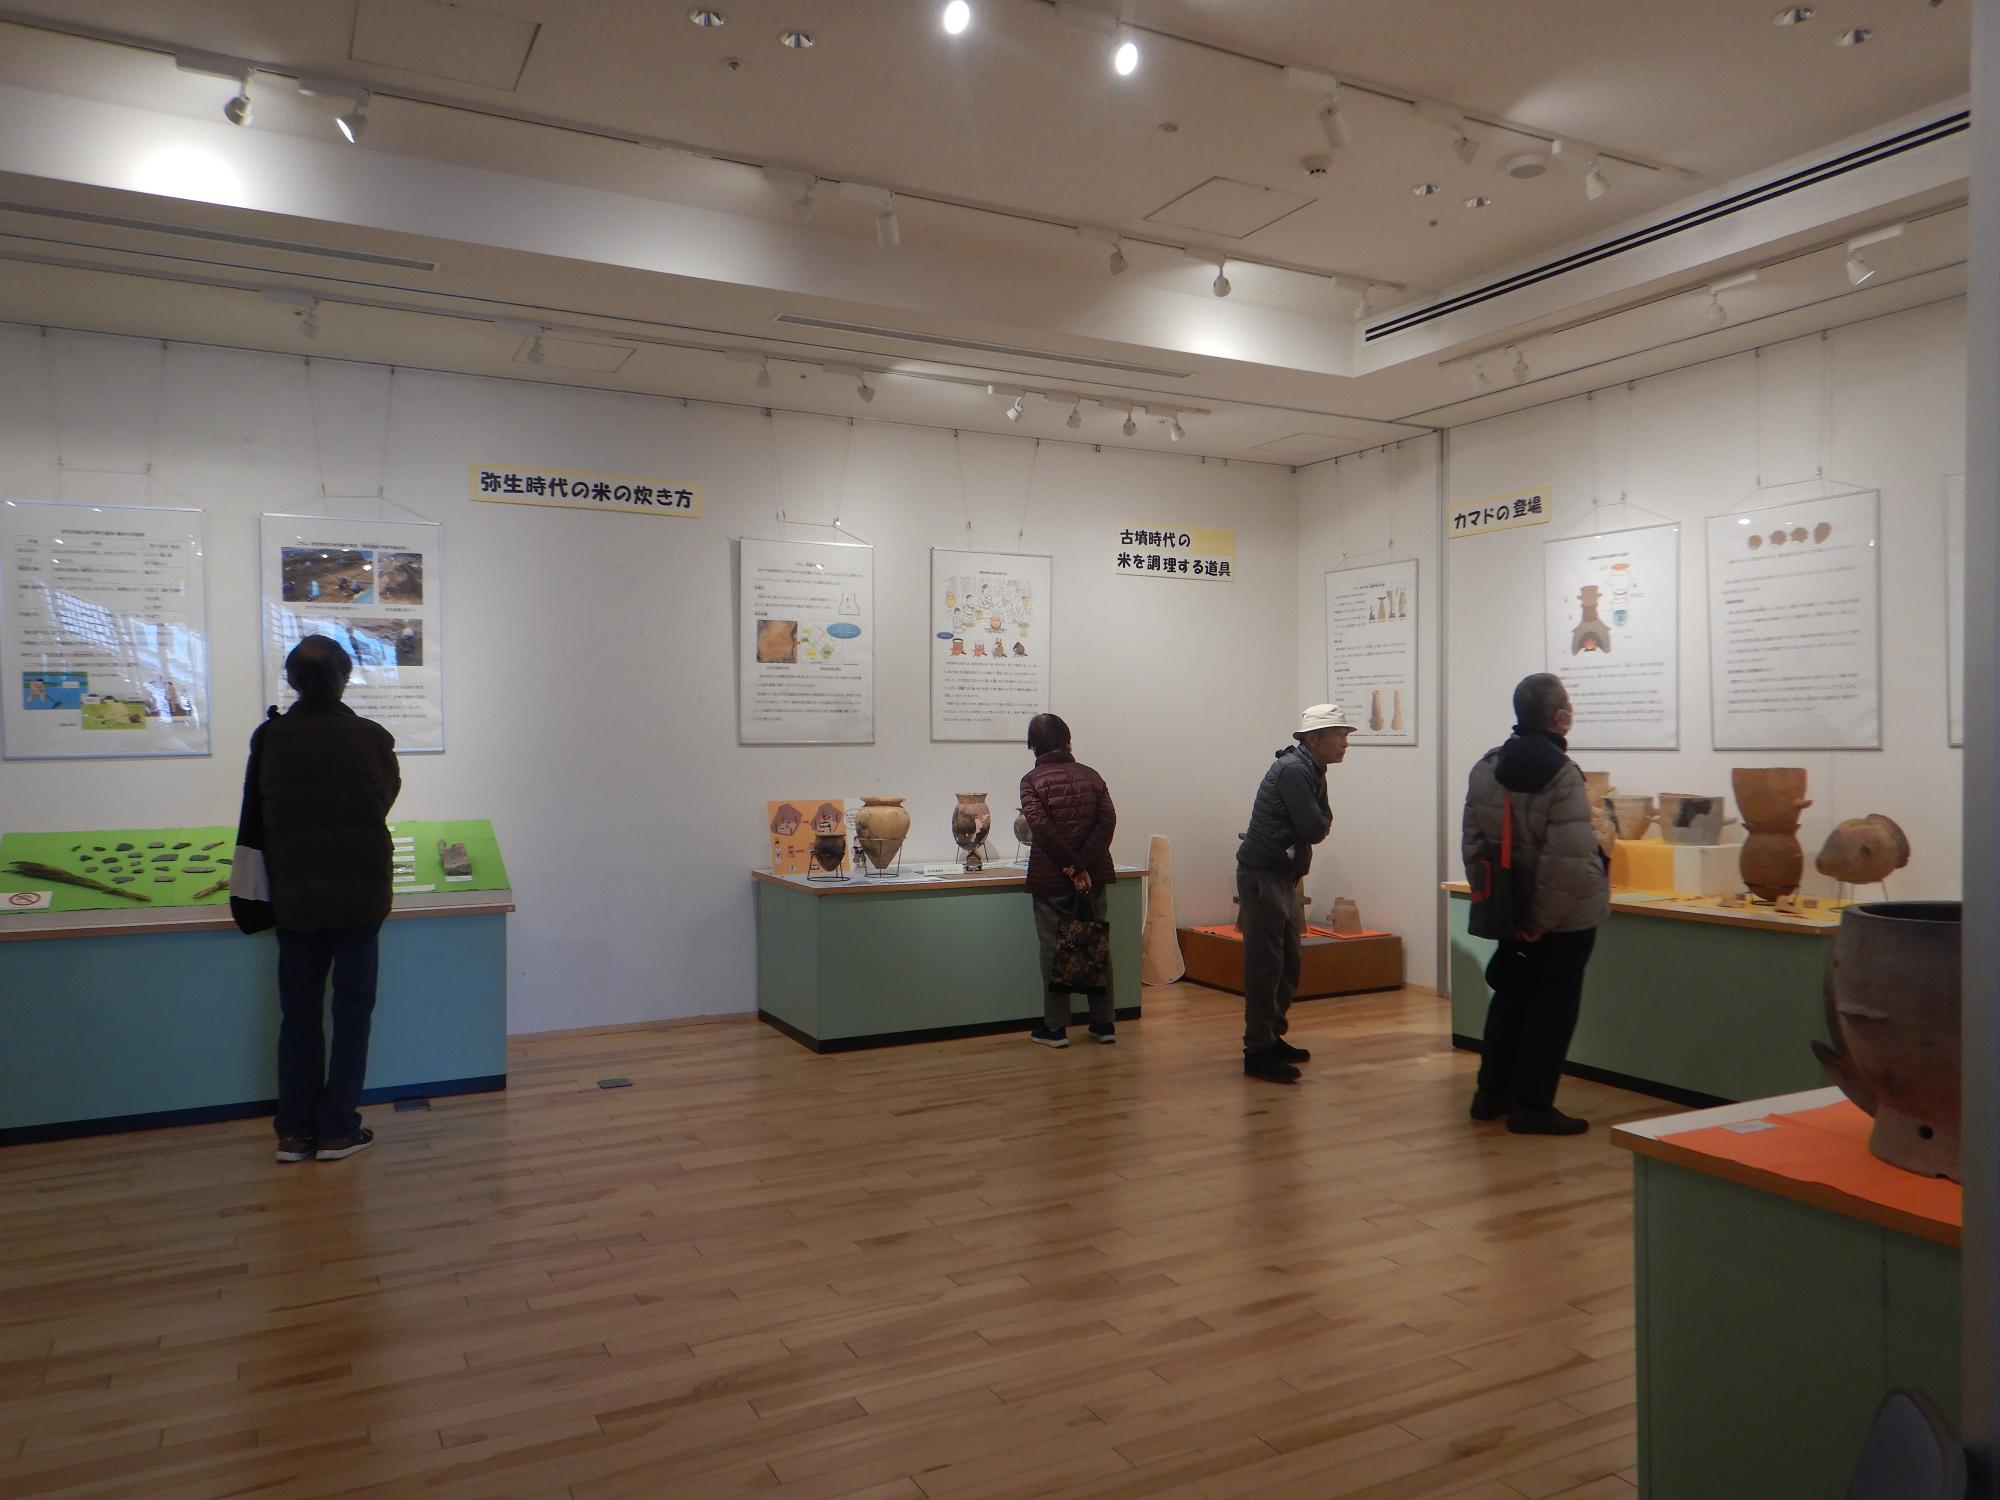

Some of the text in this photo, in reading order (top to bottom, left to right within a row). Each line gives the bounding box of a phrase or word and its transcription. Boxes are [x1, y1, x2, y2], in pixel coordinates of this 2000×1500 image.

[480, 471, 694, 509] 弥生時代の米の炊き方
[1454, 495, 1542, 530] カマドの登場
[1120, 528, 1191, 549] 古墳時代の
[1117, 552, 1231, 577] 米を調理する道具
